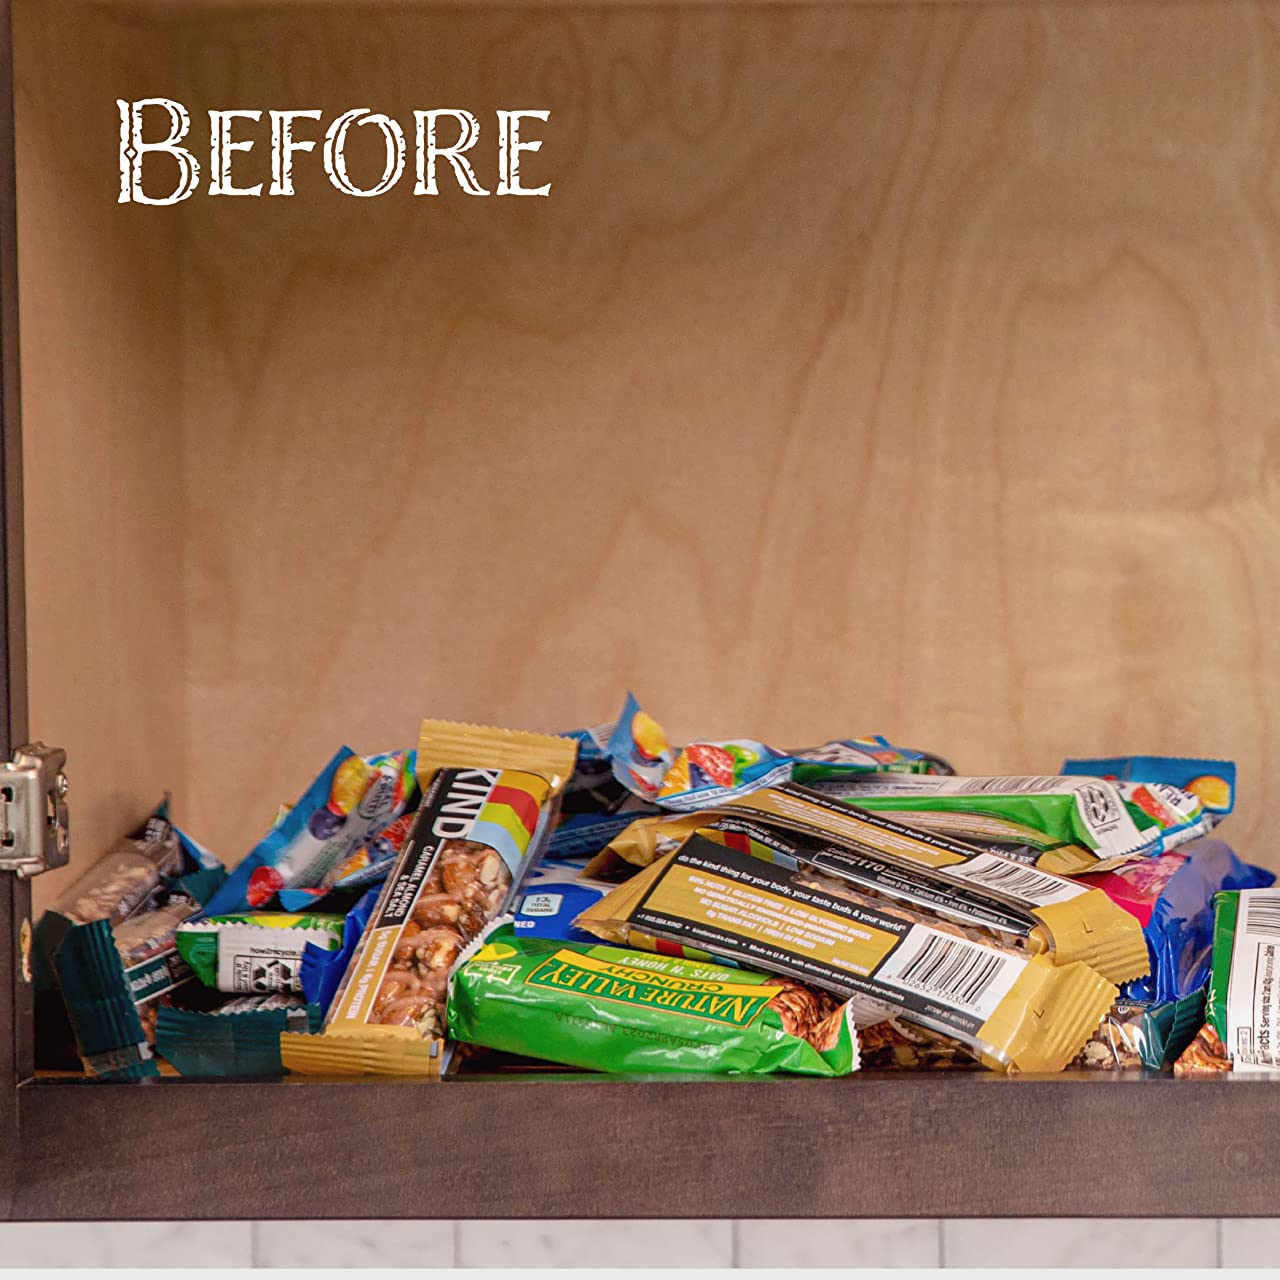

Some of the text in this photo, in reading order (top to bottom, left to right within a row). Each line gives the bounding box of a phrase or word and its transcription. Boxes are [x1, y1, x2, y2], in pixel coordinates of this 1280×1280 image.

[432, 769, 501, 839] KIND
[858, 857, 884, 872] 170
[678, 854, 689, 862] do
[690, 856, 703, 867] the
[704, 860, 720, 872] kind
[720, 864, 741, 880] thing
[740, 870, 753, 881] for
[752, 876, 770, 890] your
[771, 879, 791, 895] body,
[791, 889, 811, 902] your
[812, 893, 832, 908] taste
[832, 900, 852, 915] buds
[852, 908, 860, 917] &
[859, 912, 880, 926] your
[749, 944, 767, 956] Made
[618, 956, 666, 973] HONEY
[691, 968, 730, 981] OATS
[601, 965, 723, 993] CRUNCHY
[540, 963, 760, 1022] NATURE VALLEY
